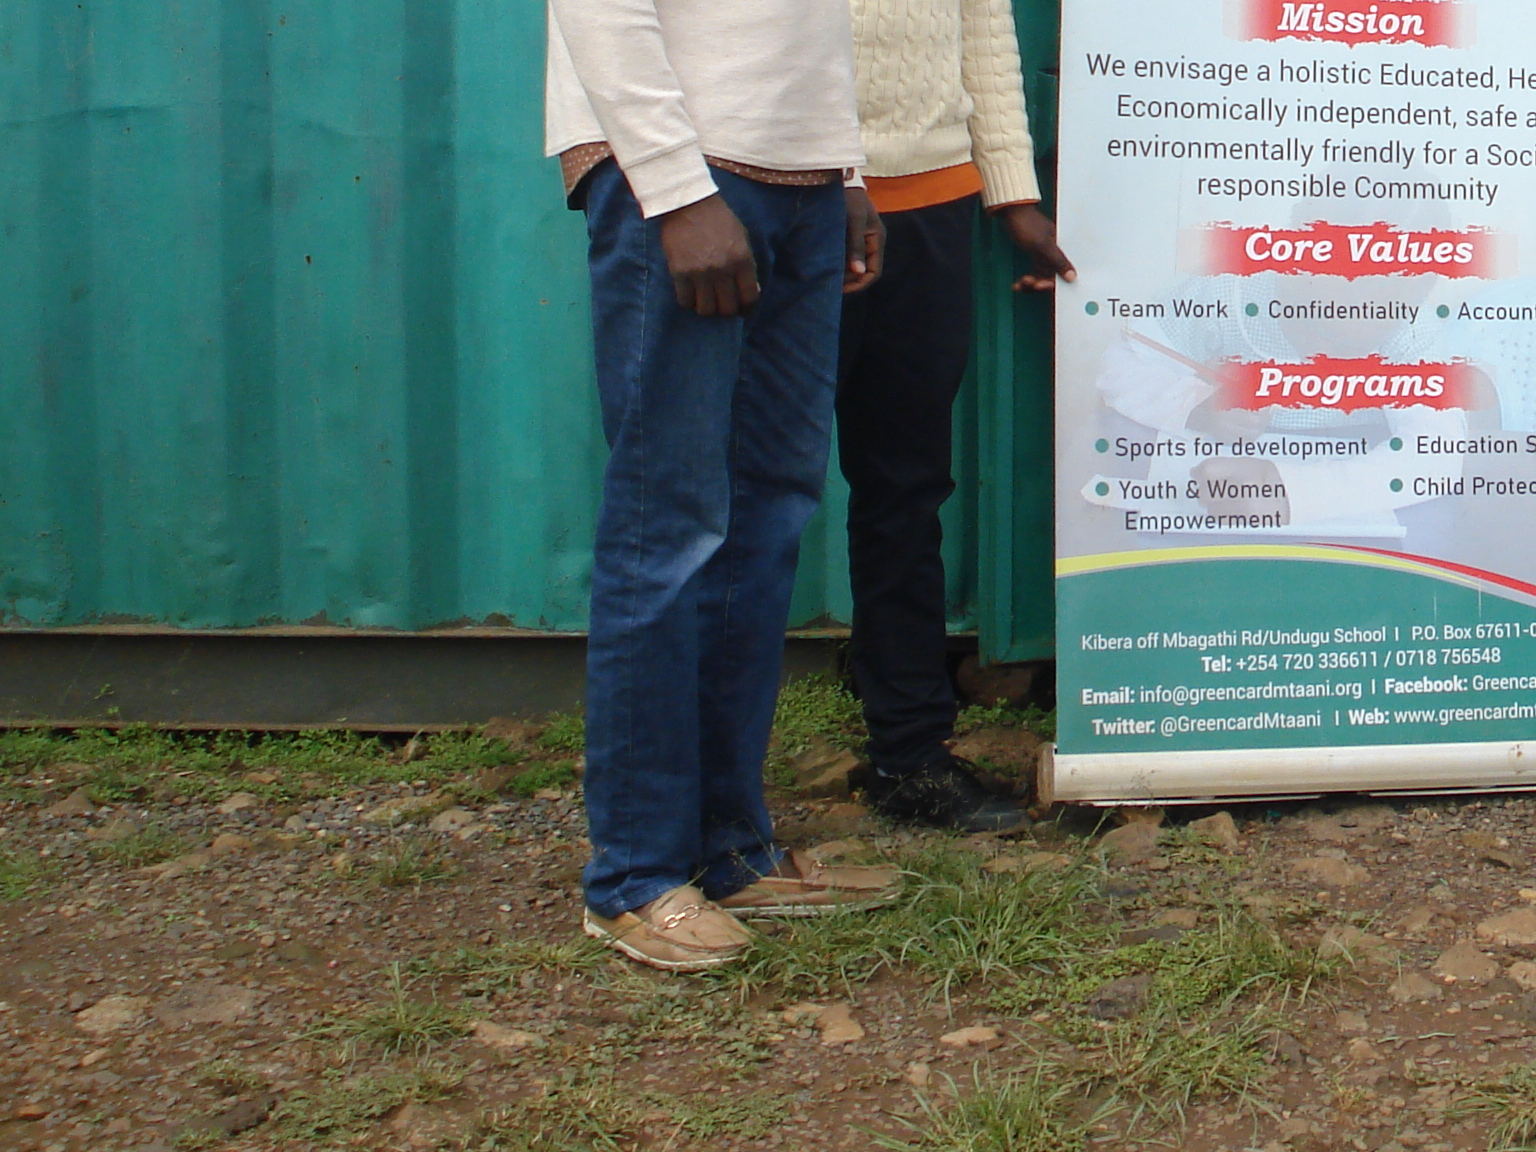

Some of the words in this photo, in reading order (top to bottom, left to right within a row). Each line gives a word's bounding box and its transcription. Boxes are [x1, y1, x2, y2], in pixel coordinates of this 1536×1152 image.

[1278, 3, 1424, 35] Mission
[1087, 54, 1125, 76] We
[1135, 56, 1247, 86] envisage
[1257, 65, 1269, 81] a
[1281, 59, 1370, 84] holistic
[1381, 63, 1499, 91] Educated,
[1118, 95, 1287, 127] Economically
[1298, 99, 1456, 128] independent,
[1466, 104, 1517, 127] safe
[1108, 134, 1313, 167] environmentally
[1322, 139, 1415, 169] friendly
[1424, 141, 1457, 164] for
[1466, 149, 1478, 164] a
[1199, 174, 1345, 201] responsible
[1355, 176, 1498, 206] Community
[1246, 232, 1332, 261] Core
[1348, 234, 1473, 263] Values
[1107, 299, 1164, 317] Team
[1173, 299, 1227, 318] Work
[1269, 300, 1419, 324] Confidentiality
[1256, 368, 1444, 404] Programs
[1116, 438, 1185, 461] Sports
[1195, 438, 1224, 455] for
[1232, 437, 1366, 460] development
[1418, 436, 1517, 453] Education
[1119, 481, 1176, 499] Youth
[1186, 480, 1199, 498] &
[1207, 480, 1285, 498] Women
[1414, 477, 1463, 495] Child
[1126, 511, 1280, 535] Empowerment
[1082, 634, 1132, 650] Kibera
[1137, 632, 1159, 649] off
[1163, 630, 1236, 651] Mbagathi
[1242, 629, 1329, 647] Rd/Undugu
[1334, 626, 1385, 643] School
[1412, 625, 1439, 640] P.O.
[1444, 625, 1471, 640] Box
[1201, 655, 1231, 672] Tel:
[1236, 655, 1277, 671] +254
[1283, 654, 1313, 669] 720
[1319, 651, 1376, 669] 336611
[1384, 651, 1391, 667] /
[1396, 649, 1436, 666] 0718
[1441, 647, 1501, 664] 756548
[1082, 687, 1135, 705] Email:
[1141, 680, 1361, 706] info@greencardmtaani.org
[1385, 675, 1468, 694] Facebook:
[1161, 710, 1320, 737] @GreencardMtaani
[1348, 708, 1389, 725] Web:
